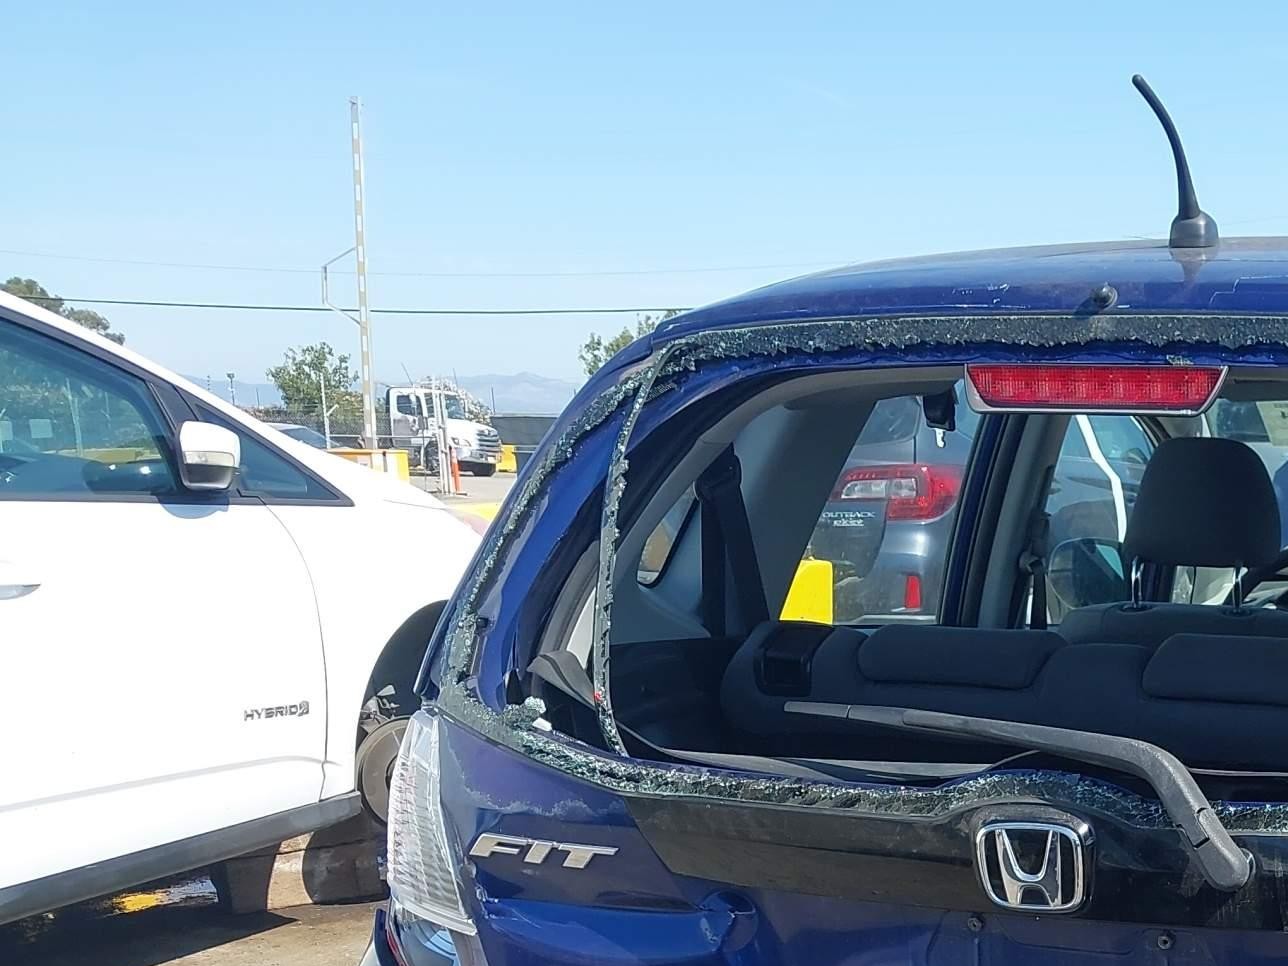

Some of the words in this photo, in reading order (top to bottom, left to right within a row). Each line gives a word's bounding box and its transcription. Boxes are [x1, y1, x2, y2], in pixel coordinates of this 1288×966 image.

[822, 511, 876, 519] OUTBACK
[243, 704, 299, 722] HYBRID
[469, 832, 620, 869] FIT
